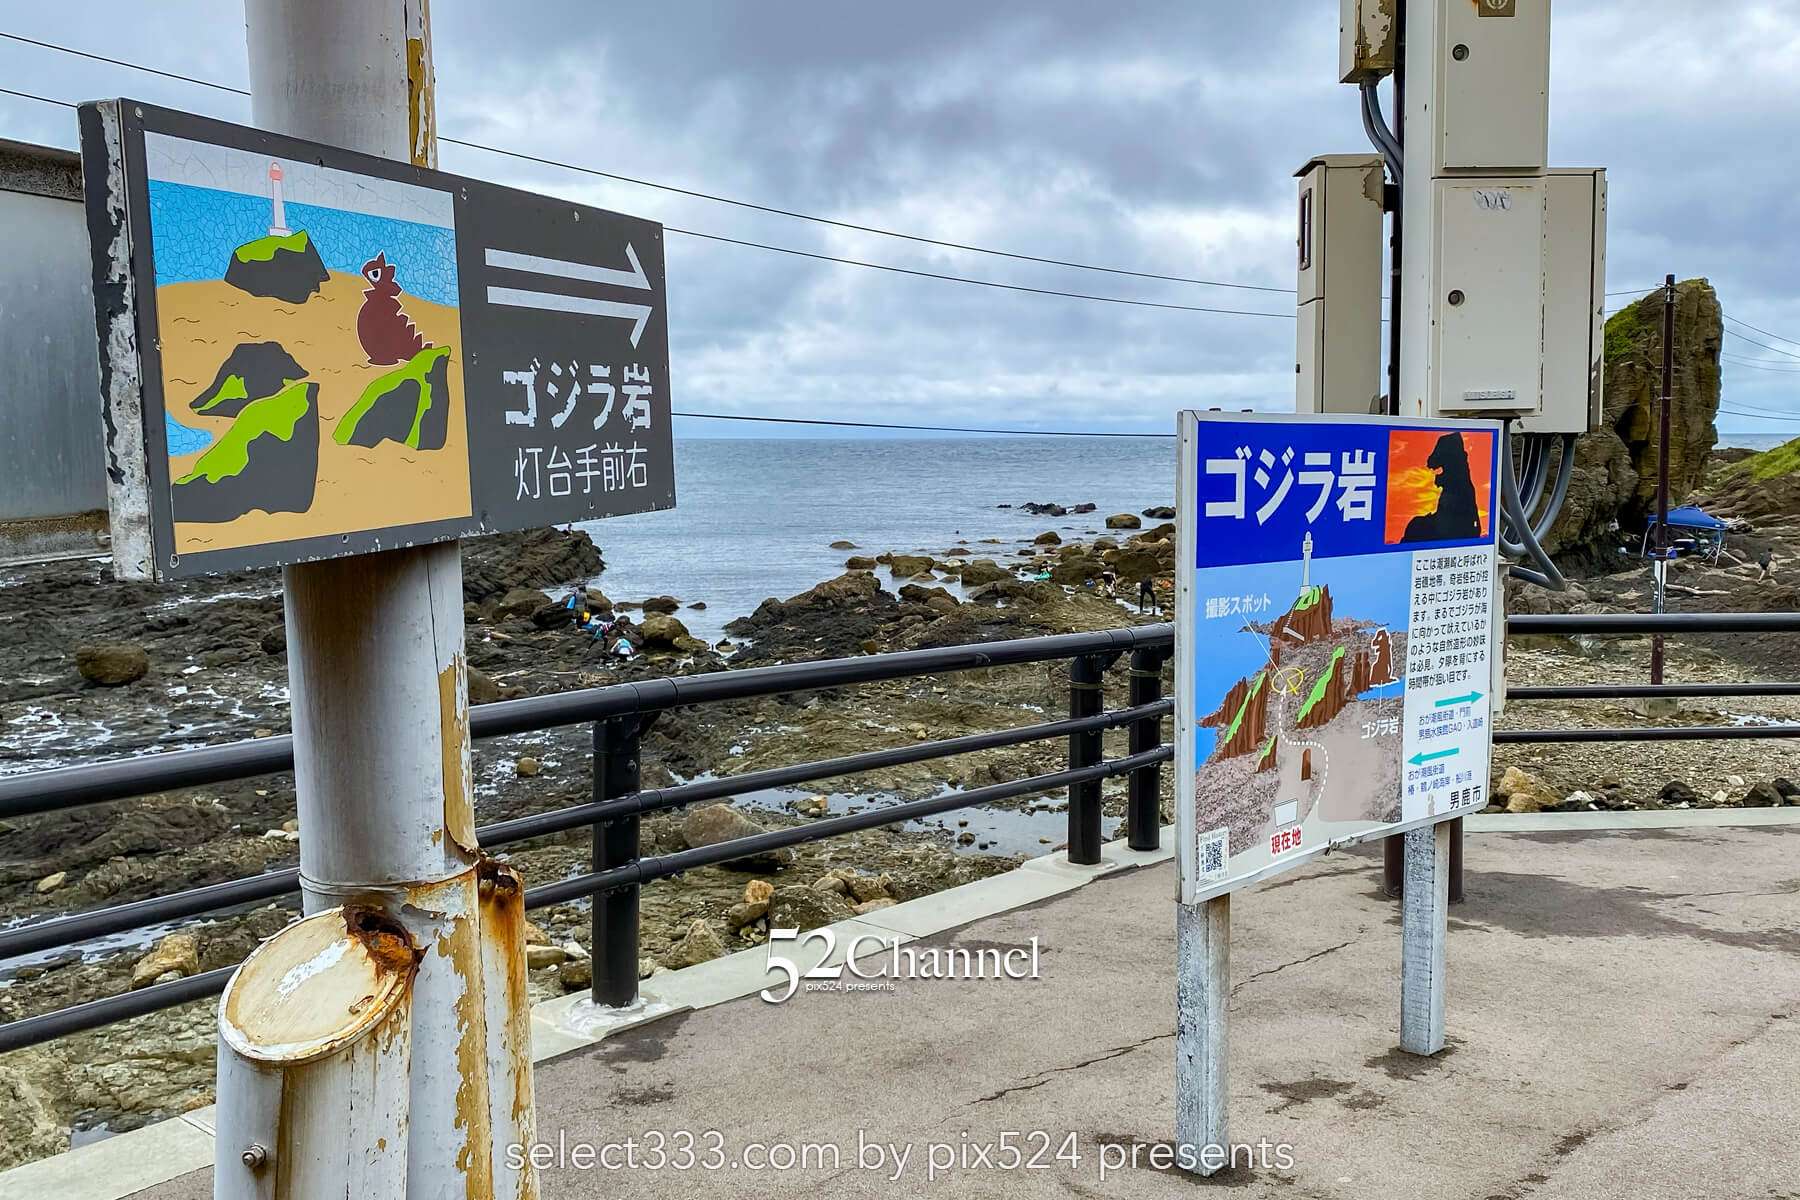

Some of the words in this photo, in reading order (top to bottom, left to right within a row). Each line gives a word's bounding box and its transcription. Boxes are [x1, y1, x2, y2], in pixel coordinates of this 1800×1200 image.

[503, 357, 652, 432] ゴジラ岩
[515, 441, 648, 500] 灯台手前右
[1205, 446, 1376, 526] ゴジラ岩
[1206, 592, 1272, 619] 撮影スポット
[1414, 587, 1487, 605] える中にゴジラ岩があり
[1413, 602, 1487, 622] ます。まるでゴジラが海
[1361, 716, 1399, 739] ゴジラ岩
[1450, 785, 1482, 810] 男鹿市
[1271, 827, 1302, 854] 現在地
